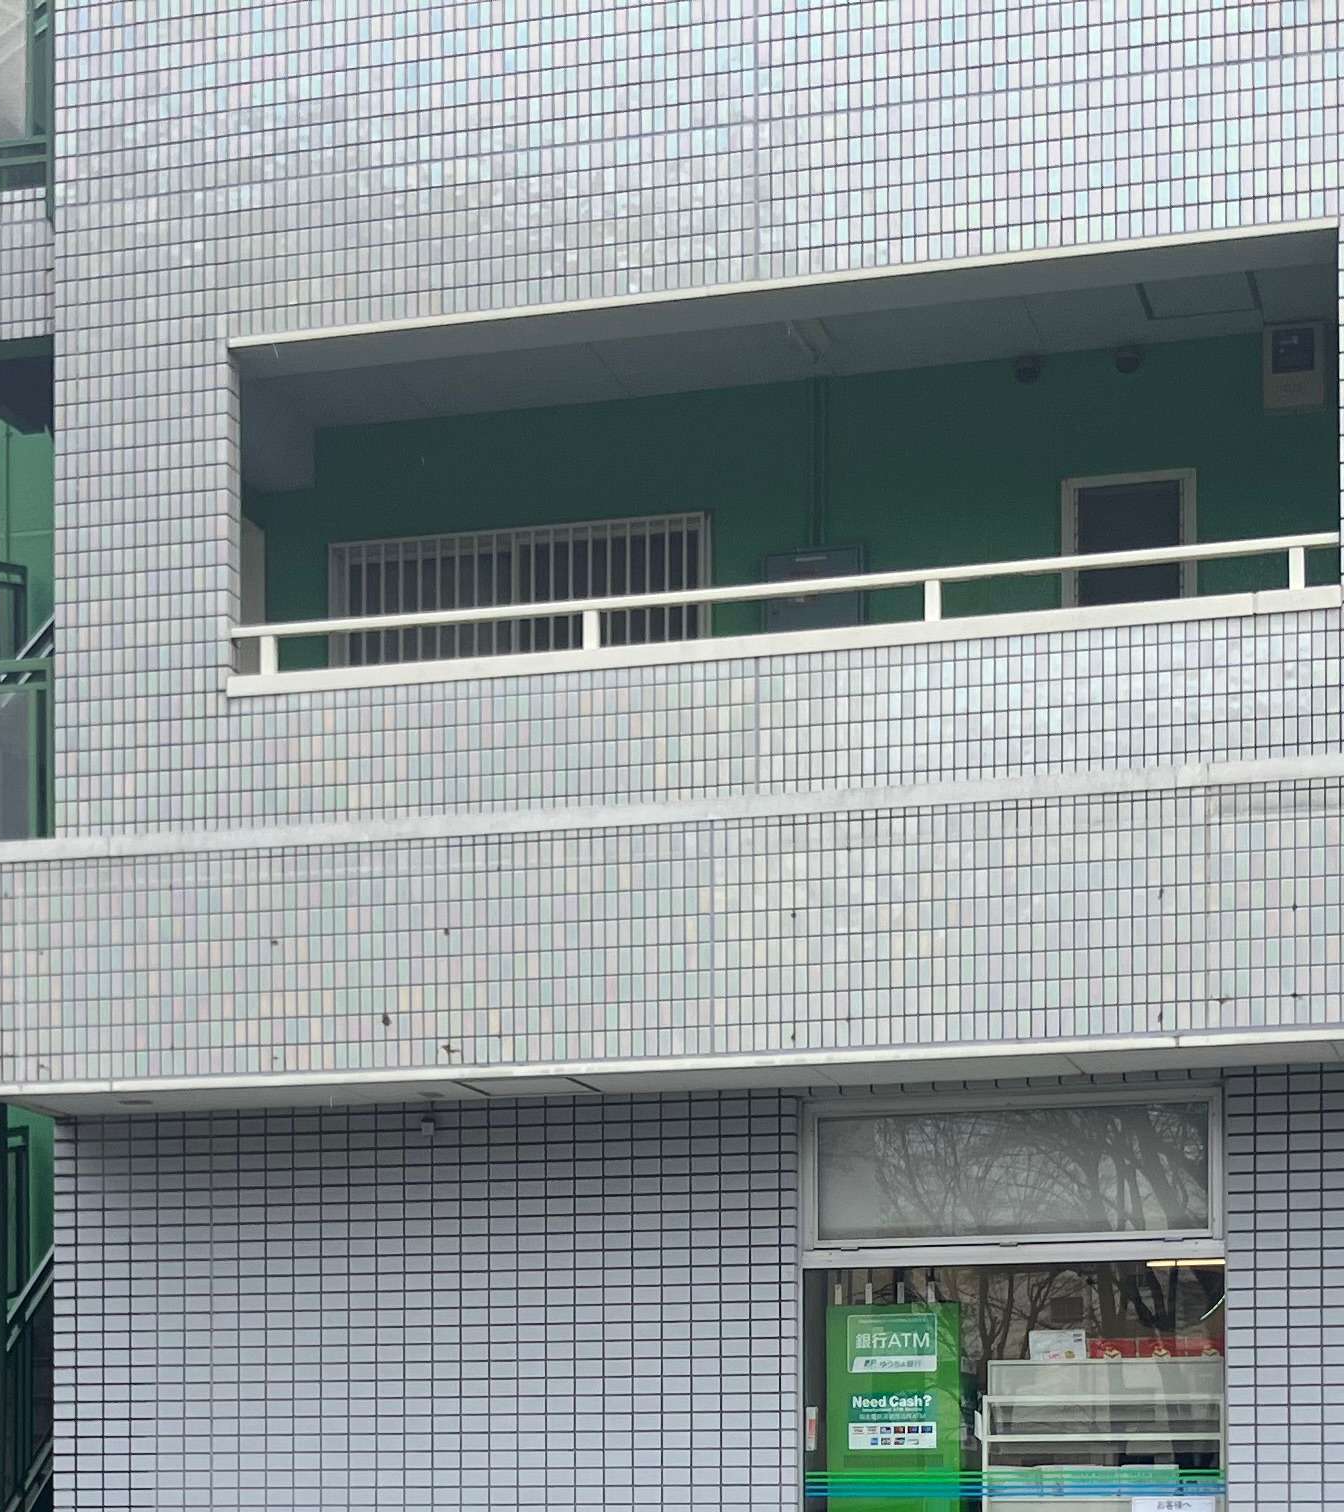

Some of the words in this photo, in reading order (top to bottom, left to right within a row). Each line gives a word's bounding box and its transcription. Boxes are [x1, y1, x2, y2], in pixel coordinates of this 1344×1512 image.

[855, 1332, 930, 1349] 銀行ATM
[852, 1396, 887, 1408] Need
[889, 1395, 932, 1407] Cash?
